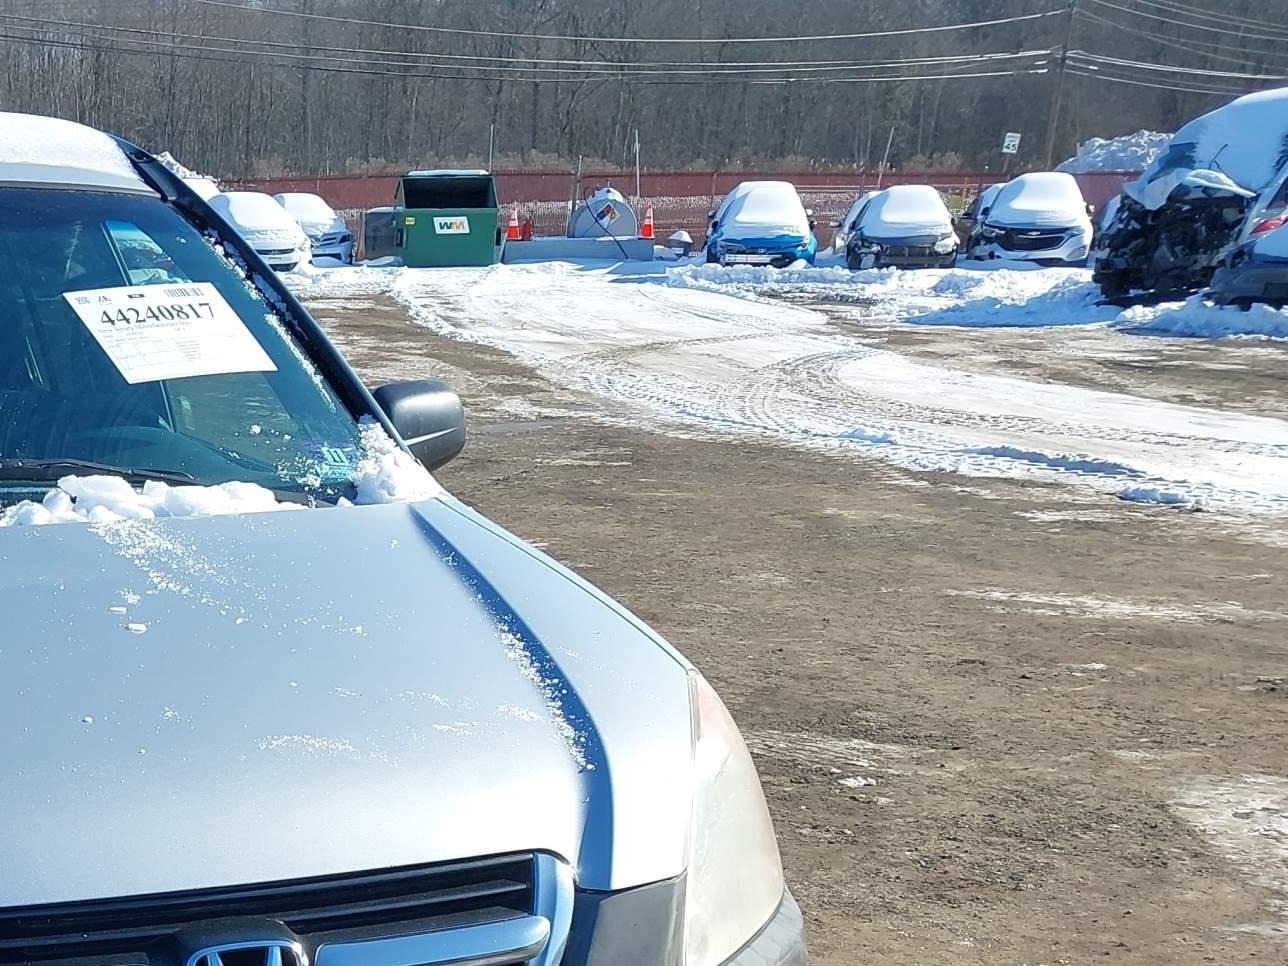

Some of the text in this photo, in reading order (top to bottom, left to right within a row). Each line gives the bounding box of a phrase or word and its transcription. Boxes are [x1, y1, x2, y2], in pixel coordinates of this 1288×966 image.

[1005, 143, 1017, 151] 45
[439, 221, 465, 230] WM
[100, 302, 215, 326] 44240817
